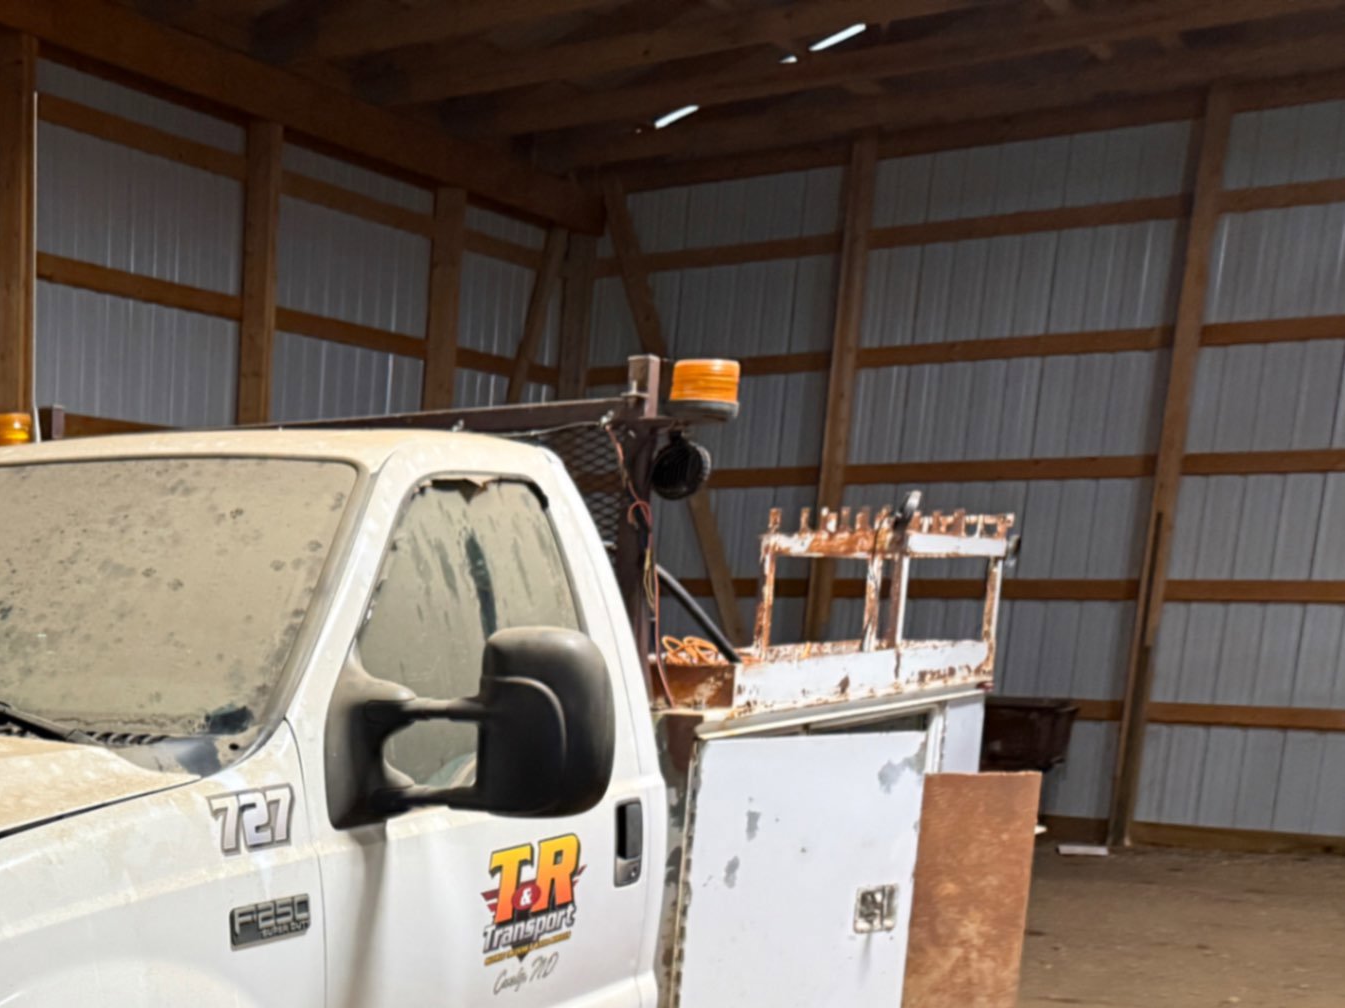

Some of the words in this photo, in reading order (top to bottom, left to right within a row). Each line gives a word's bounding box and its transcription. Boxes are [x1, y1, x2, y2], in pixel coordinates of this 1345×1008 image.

[206, 783, 295, 857] 727
[233, 894, 311, 935] F250
[483, 904, 576, 953] Transport
